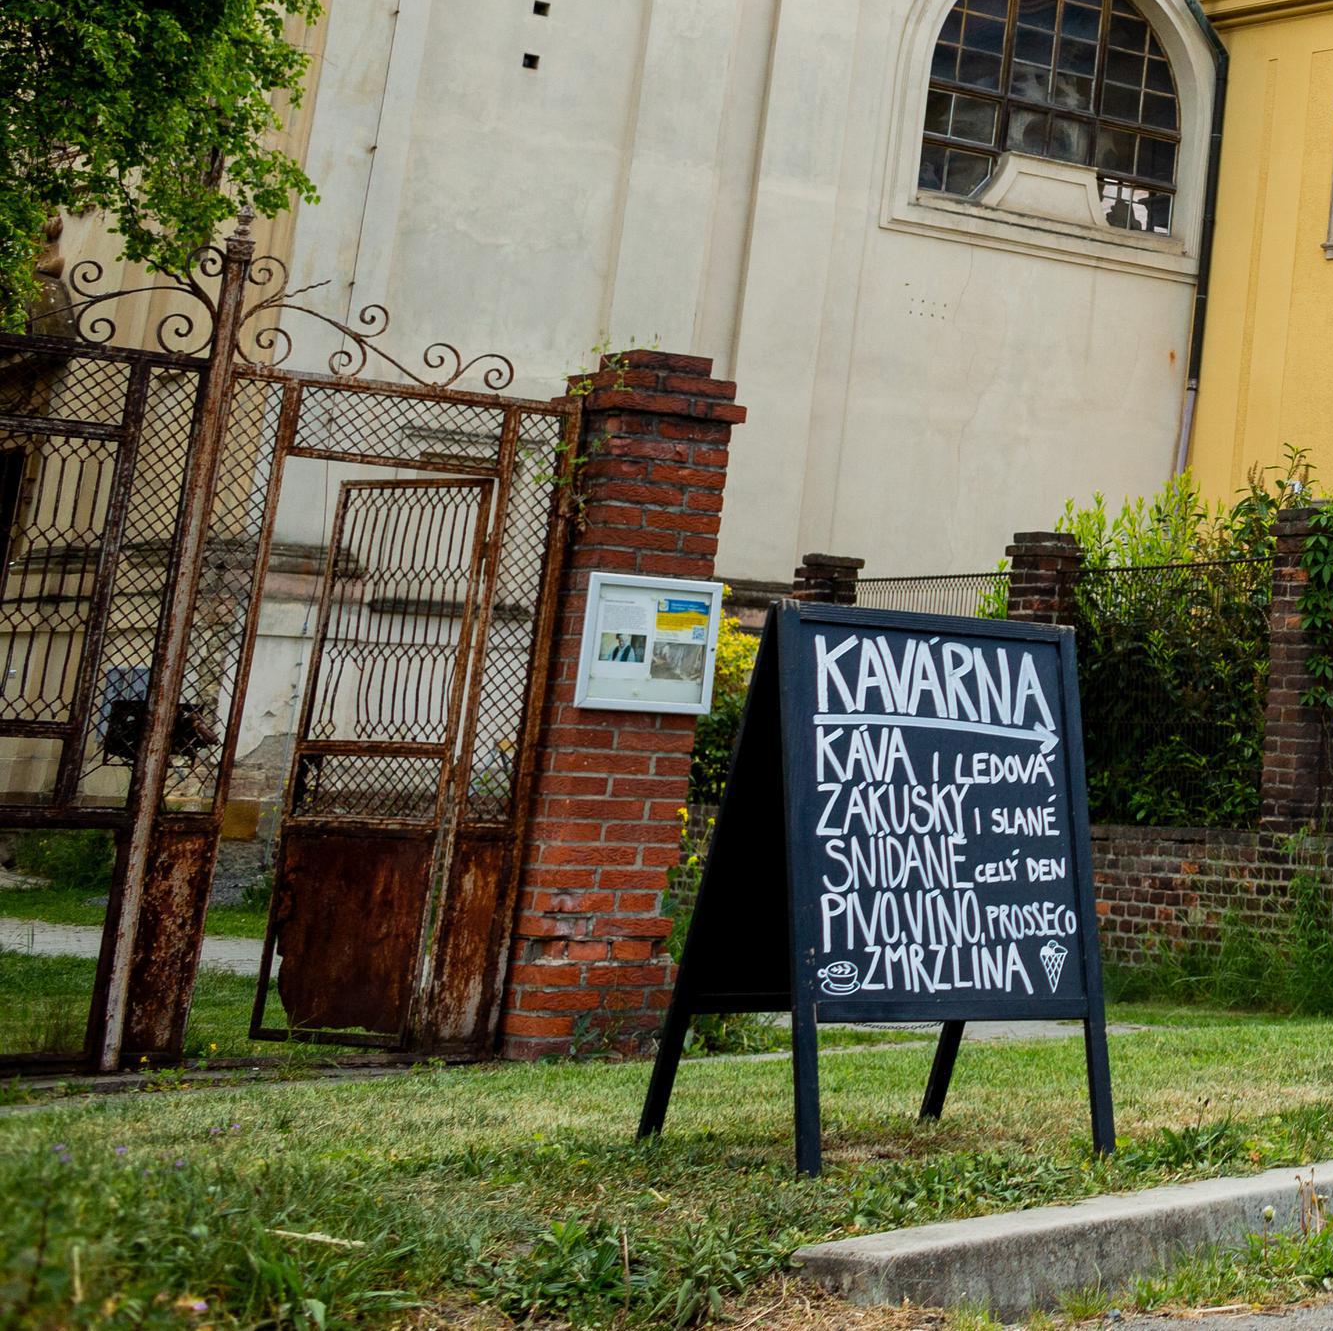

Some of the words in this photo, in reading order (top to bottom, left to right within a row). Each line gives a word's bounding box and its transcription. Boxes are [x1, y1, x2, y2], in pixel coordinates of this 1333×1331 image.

[814, 634, 1056, 731] KAVÁRNA
[816, 725, 917, 785] KÁVA
[955, 752, 1056, 787] LEDOVÁ
[815, 782, 969, 836] ZÁKUSKY
[991, 795, 1060, 837] SLANÉ
[822, 831, 975, 893] SNÍDANĚ
[975, 849, 1018, 883] CELÝ
[1027, 857, 1066, 883] DEN
[986, 901, 1077, 938] PROSSECO
[861, 942, 1034, 995] ZMRZLINA
